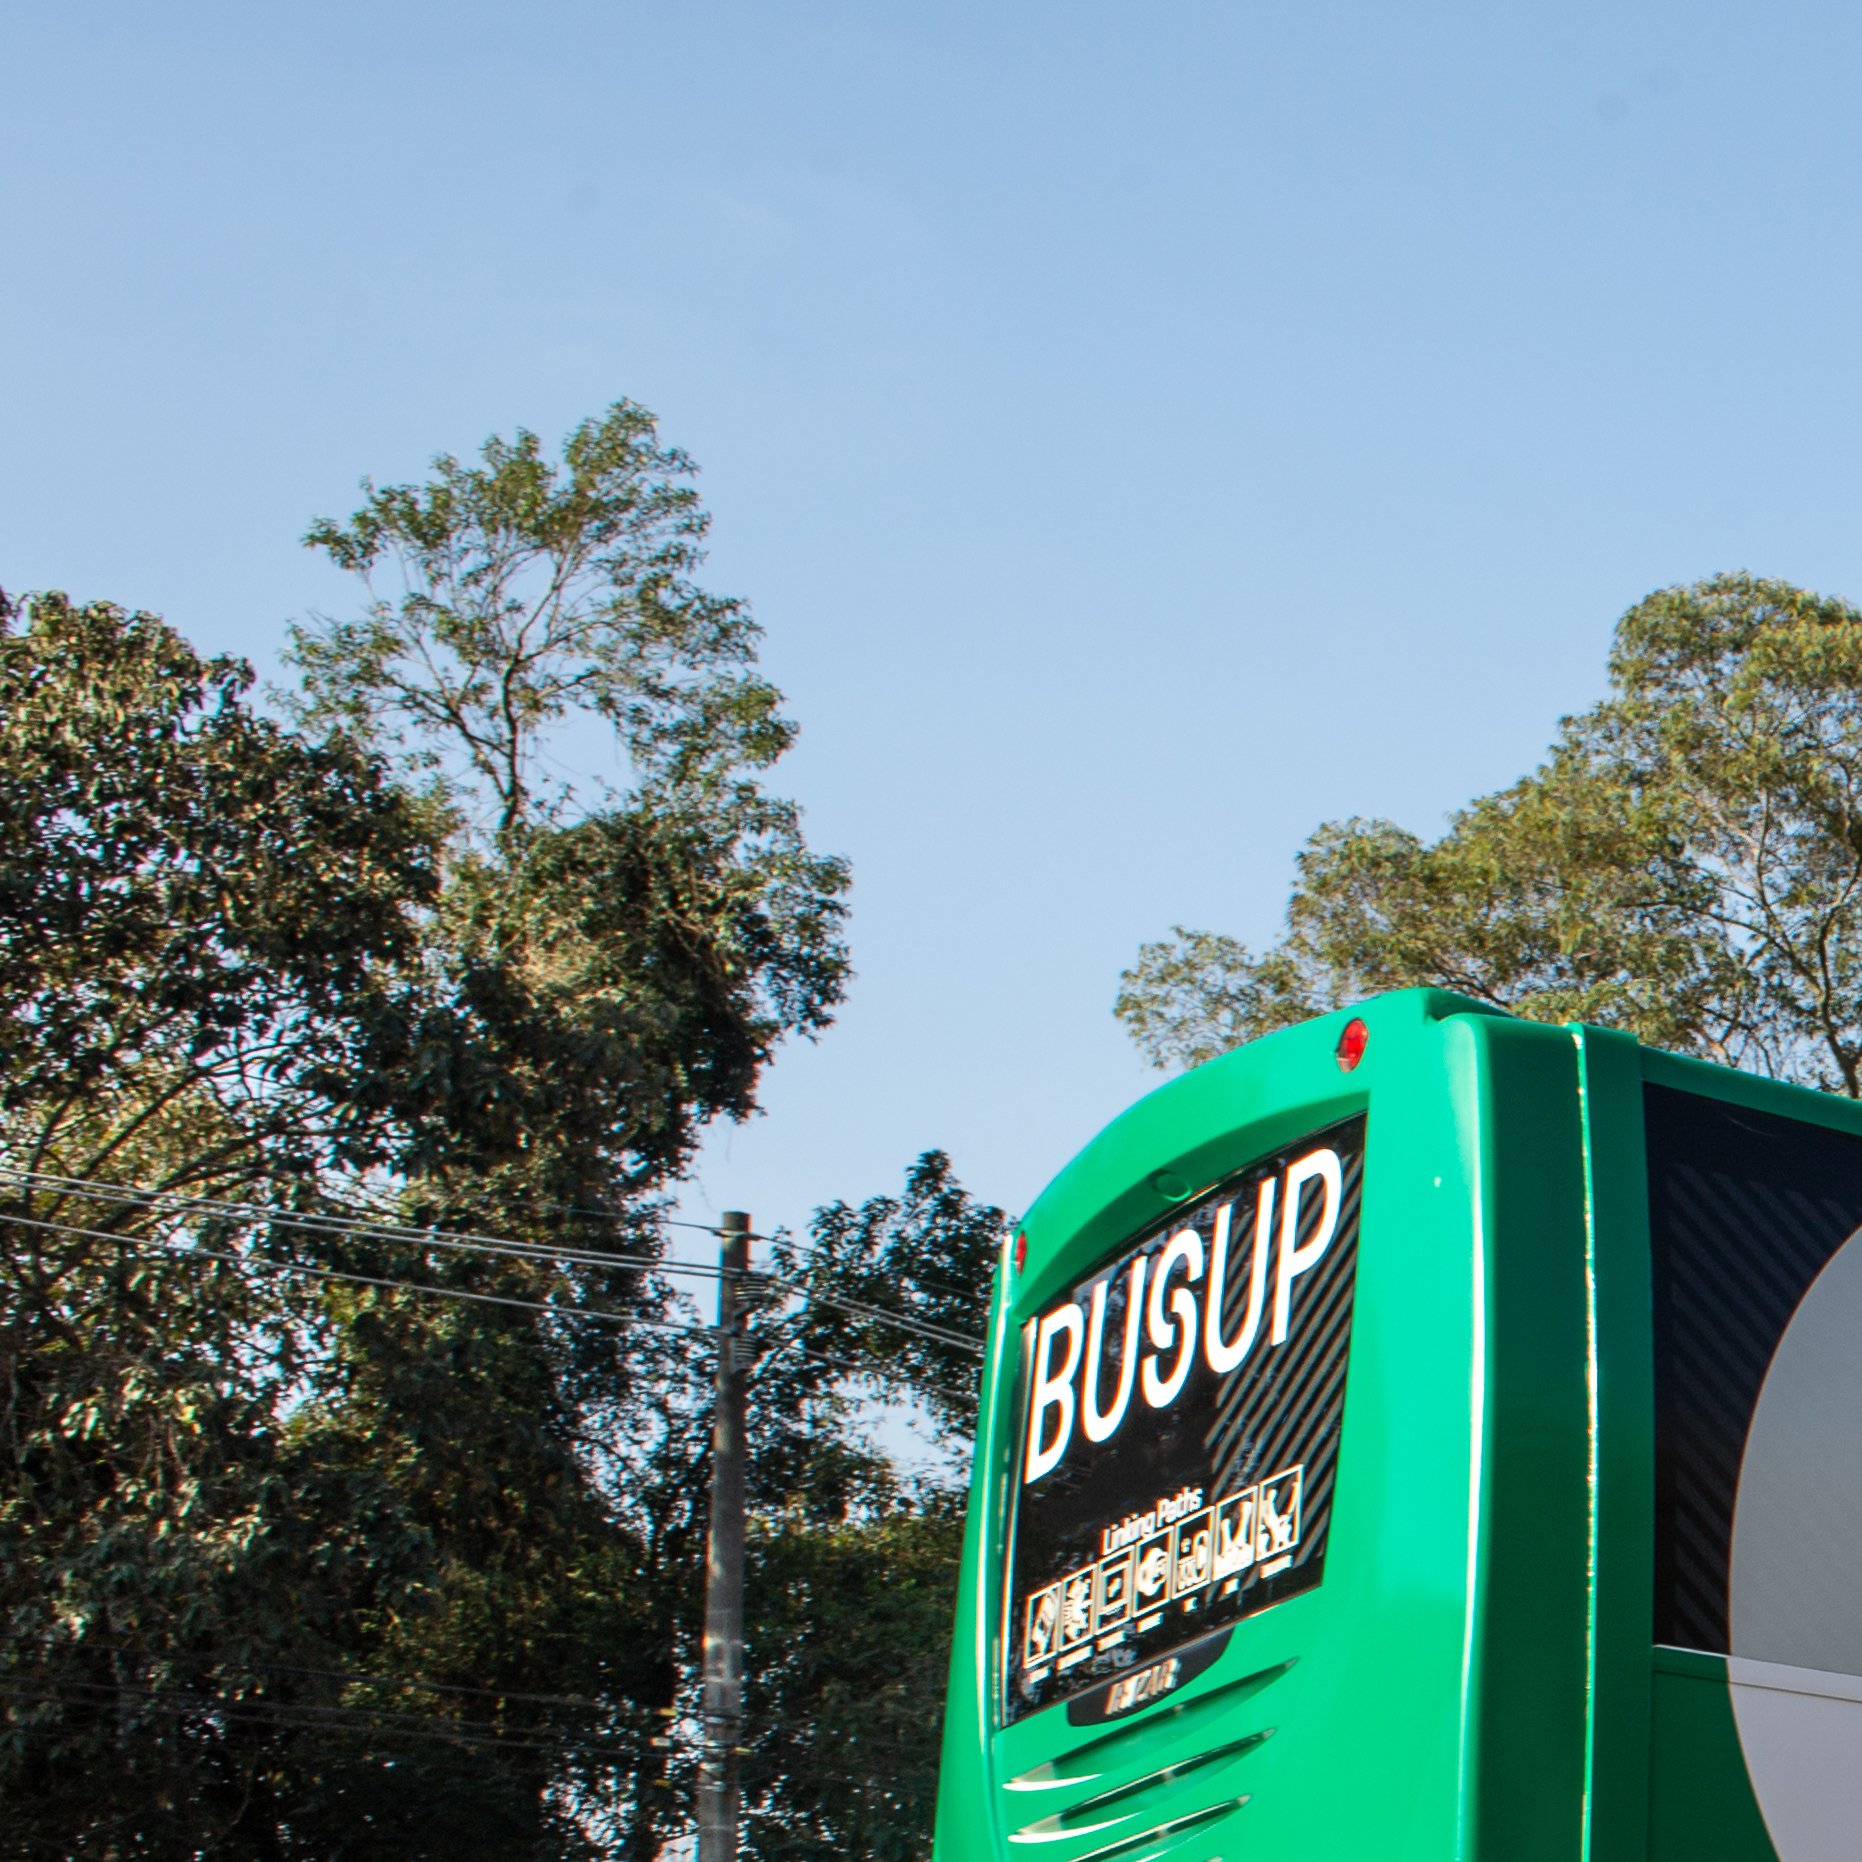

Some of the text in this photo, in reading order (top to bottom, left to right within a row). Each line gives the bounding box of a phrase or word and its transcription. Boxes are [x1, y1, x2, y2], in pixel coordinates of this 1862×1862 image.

[1023, 1147, 1343, 1484] BUSUP
[1102, 1486, 1203, 1555] Linking Paths
